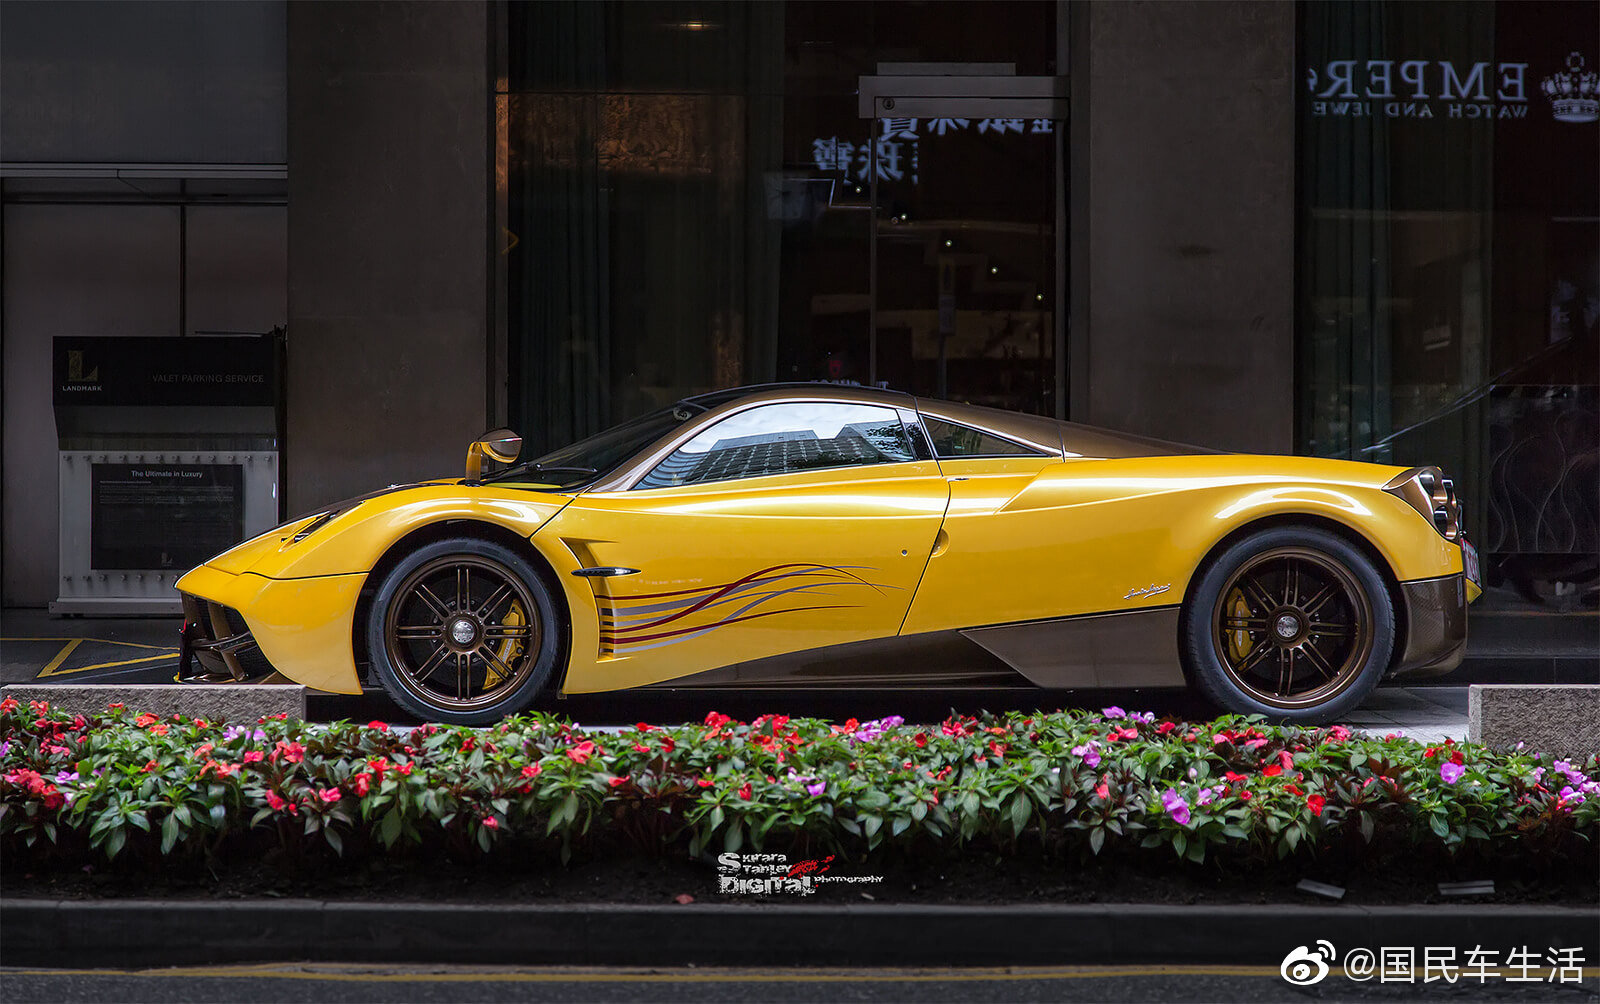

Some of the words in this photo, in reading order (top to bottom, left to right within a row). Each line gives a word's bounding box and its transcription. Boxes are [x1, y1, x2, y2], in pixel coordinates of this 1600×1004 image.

[152, 374, 180, 383] VALET
[181, 374, 223, 383] PARKING
[225, 374, 264, 383] SERVICE
[131, 470, 144, 478] The
[145, 469, 172, 478] Ultimate
[181, 469, 203, 480] Luxury
